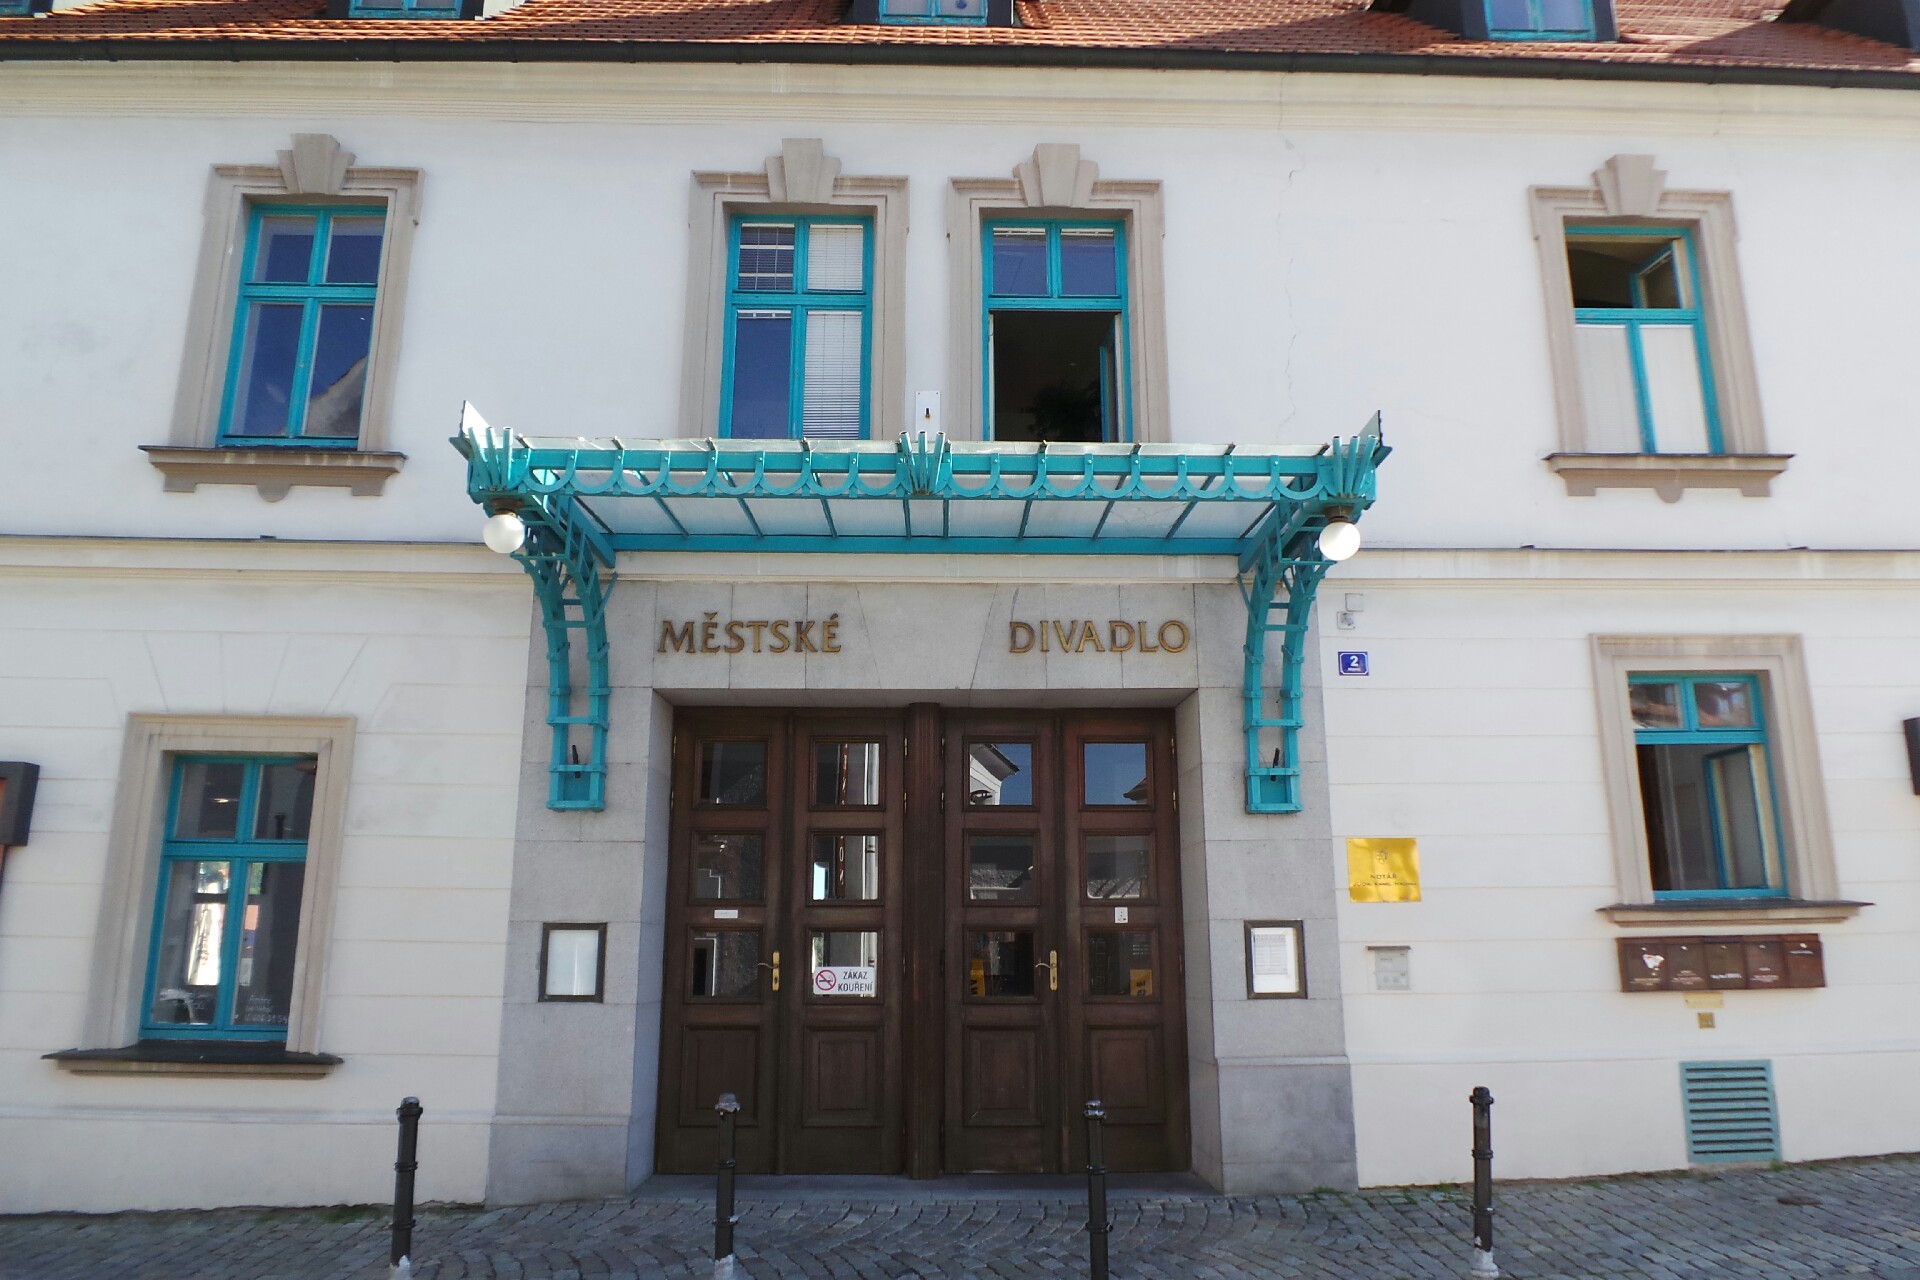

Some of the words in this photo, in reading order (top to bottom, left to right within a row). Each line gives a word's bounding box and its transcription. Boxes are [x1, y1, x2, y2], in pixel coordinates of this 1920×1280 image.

[657, 611, 842, 654] MĚSTSKÉ
[1009, 619, 1191, 654] DIVADLO
[1349, 655, 1359, 667] 2
[843, 969, 867, 979] ZÁKAZ
[838, 981, 873, 992] KOUŘENÍ
